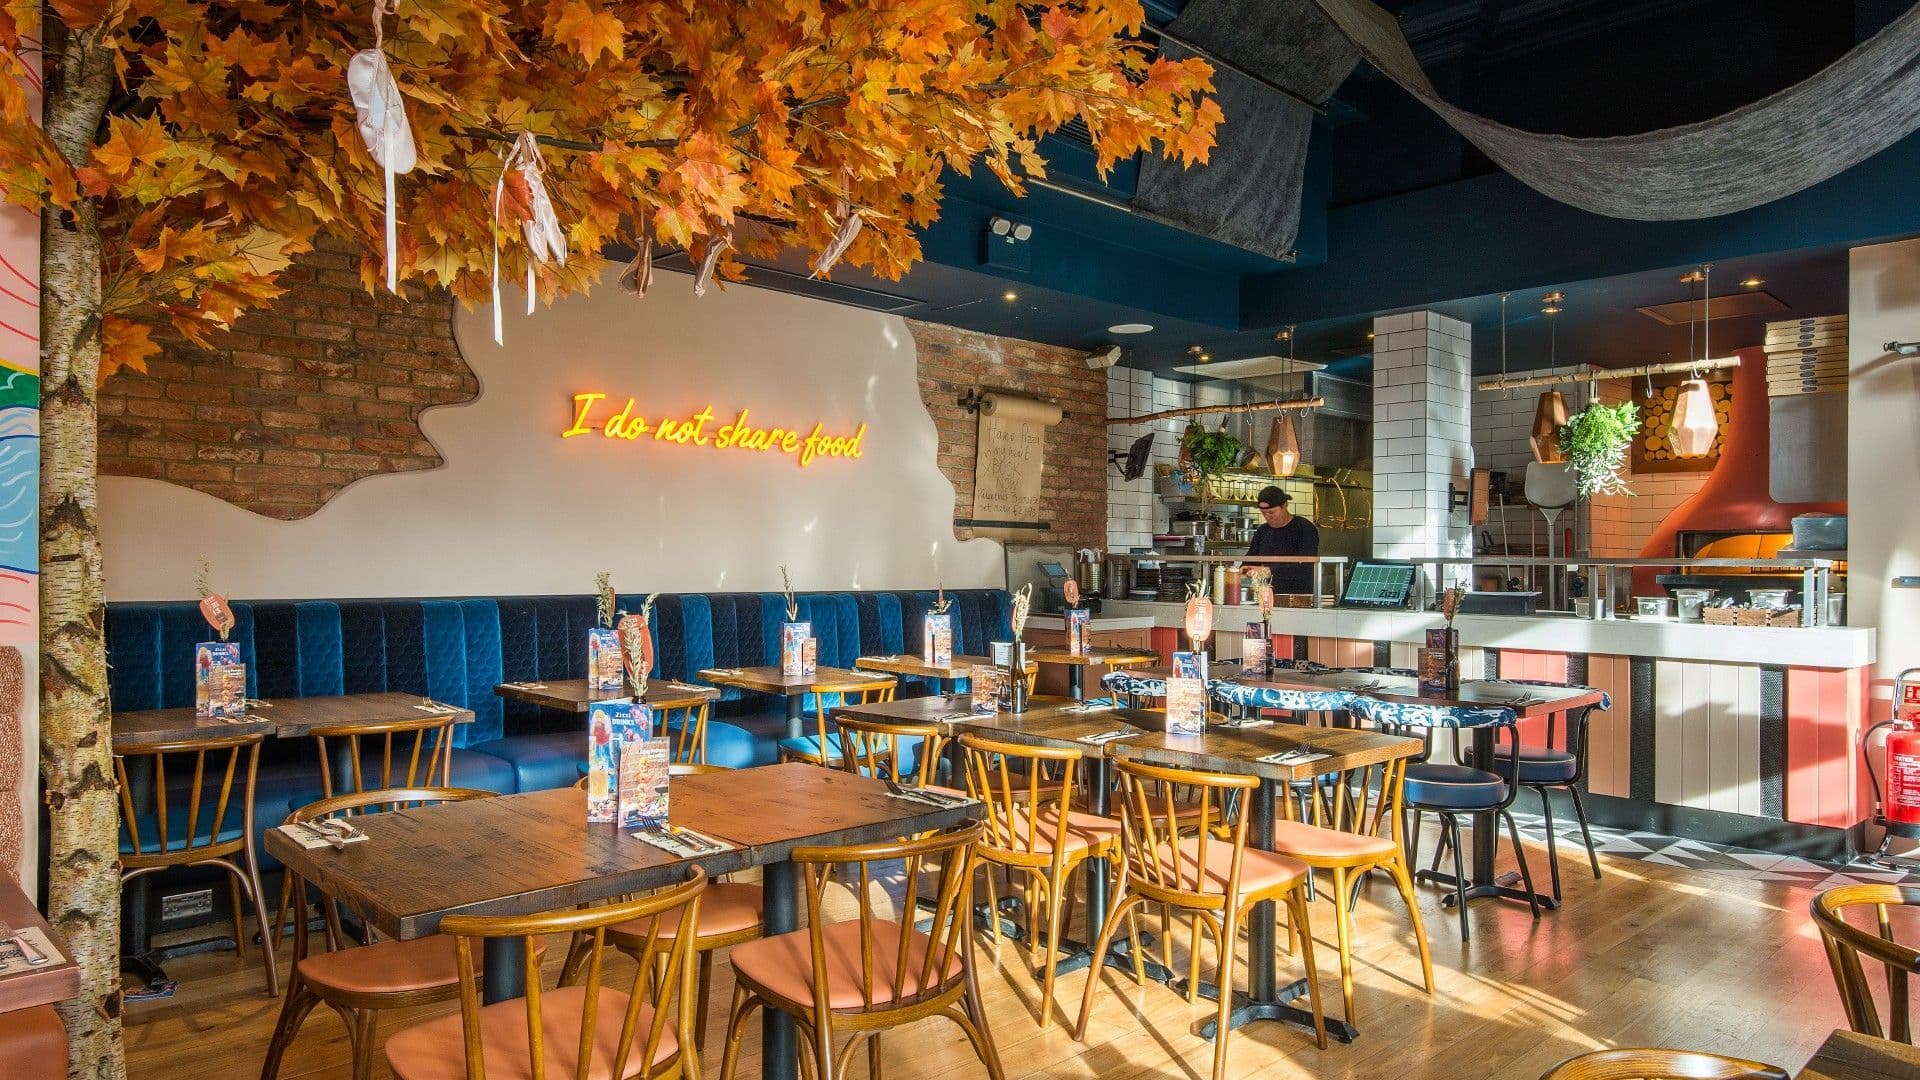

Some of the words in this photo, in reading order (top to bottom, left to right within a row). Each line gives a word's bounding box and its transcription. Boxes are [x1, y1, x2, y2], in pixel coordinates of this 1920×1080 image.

[562, 393, 606, 438] I
[604, 398, 649, 440] do
[654, 404, 716, 445] not
[716, 408, 800, 453] share
[799, 422, 867, 468] food
